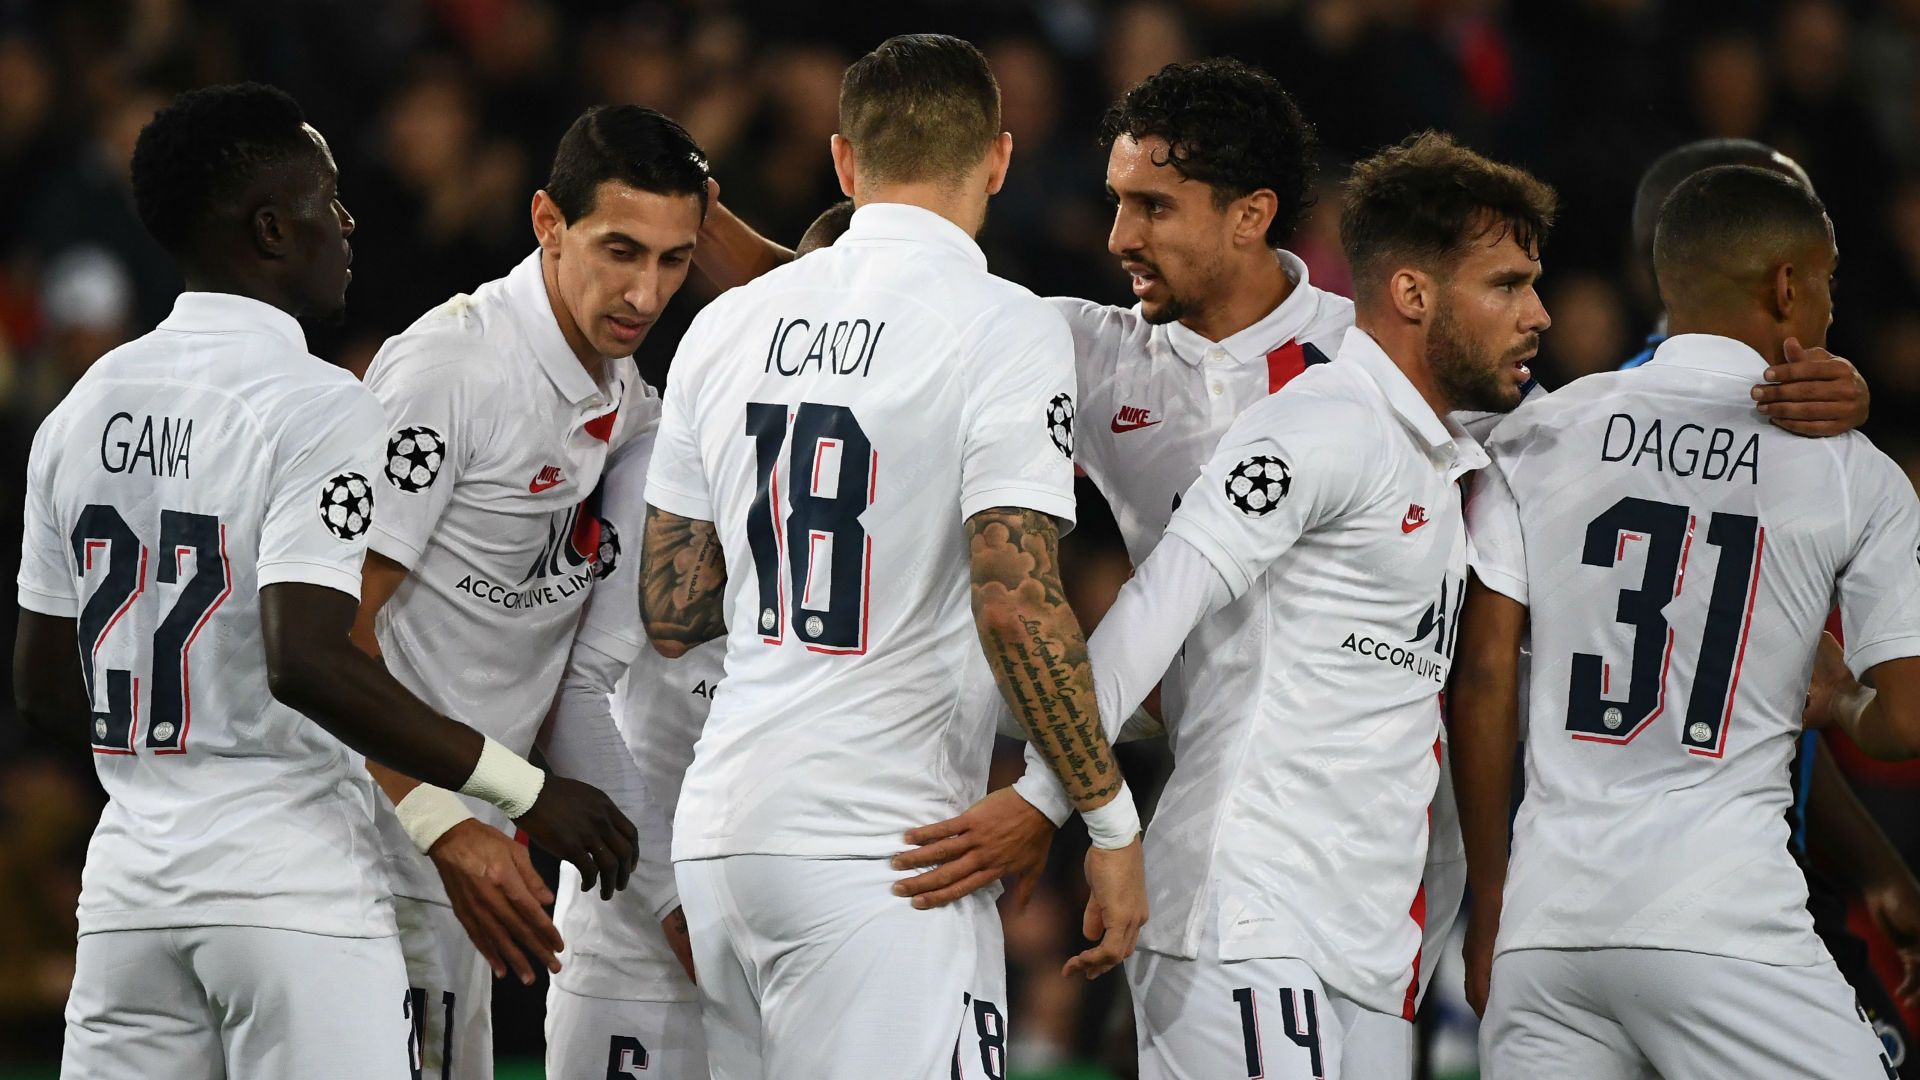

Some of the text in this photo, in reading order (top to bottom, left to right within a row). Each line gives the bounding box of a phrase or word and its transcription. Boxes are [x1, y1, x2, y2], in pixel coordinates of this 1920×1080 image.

[764, 317, 886, 378] ICARDI
[101, 412, 193, 479] GANA
[1118, 405, 1151, 423] NIKE
[537, 464, 561, 482] NIKE
[1602, 413, 1760, 484] DAGBA
[745, 402, 878, 656] 18
[1407, 503, 1426, 522] NIKE
[71, 504, 232, 755] 27
[524, 587, 558, 608] LIVE
[1565, 496, 1765, 759] 31
[1341, 632, 1416, 671] ACCOR
[1417, 657, 1442, 683] LIVE
[1233, 987, 1325, 1080] 14
